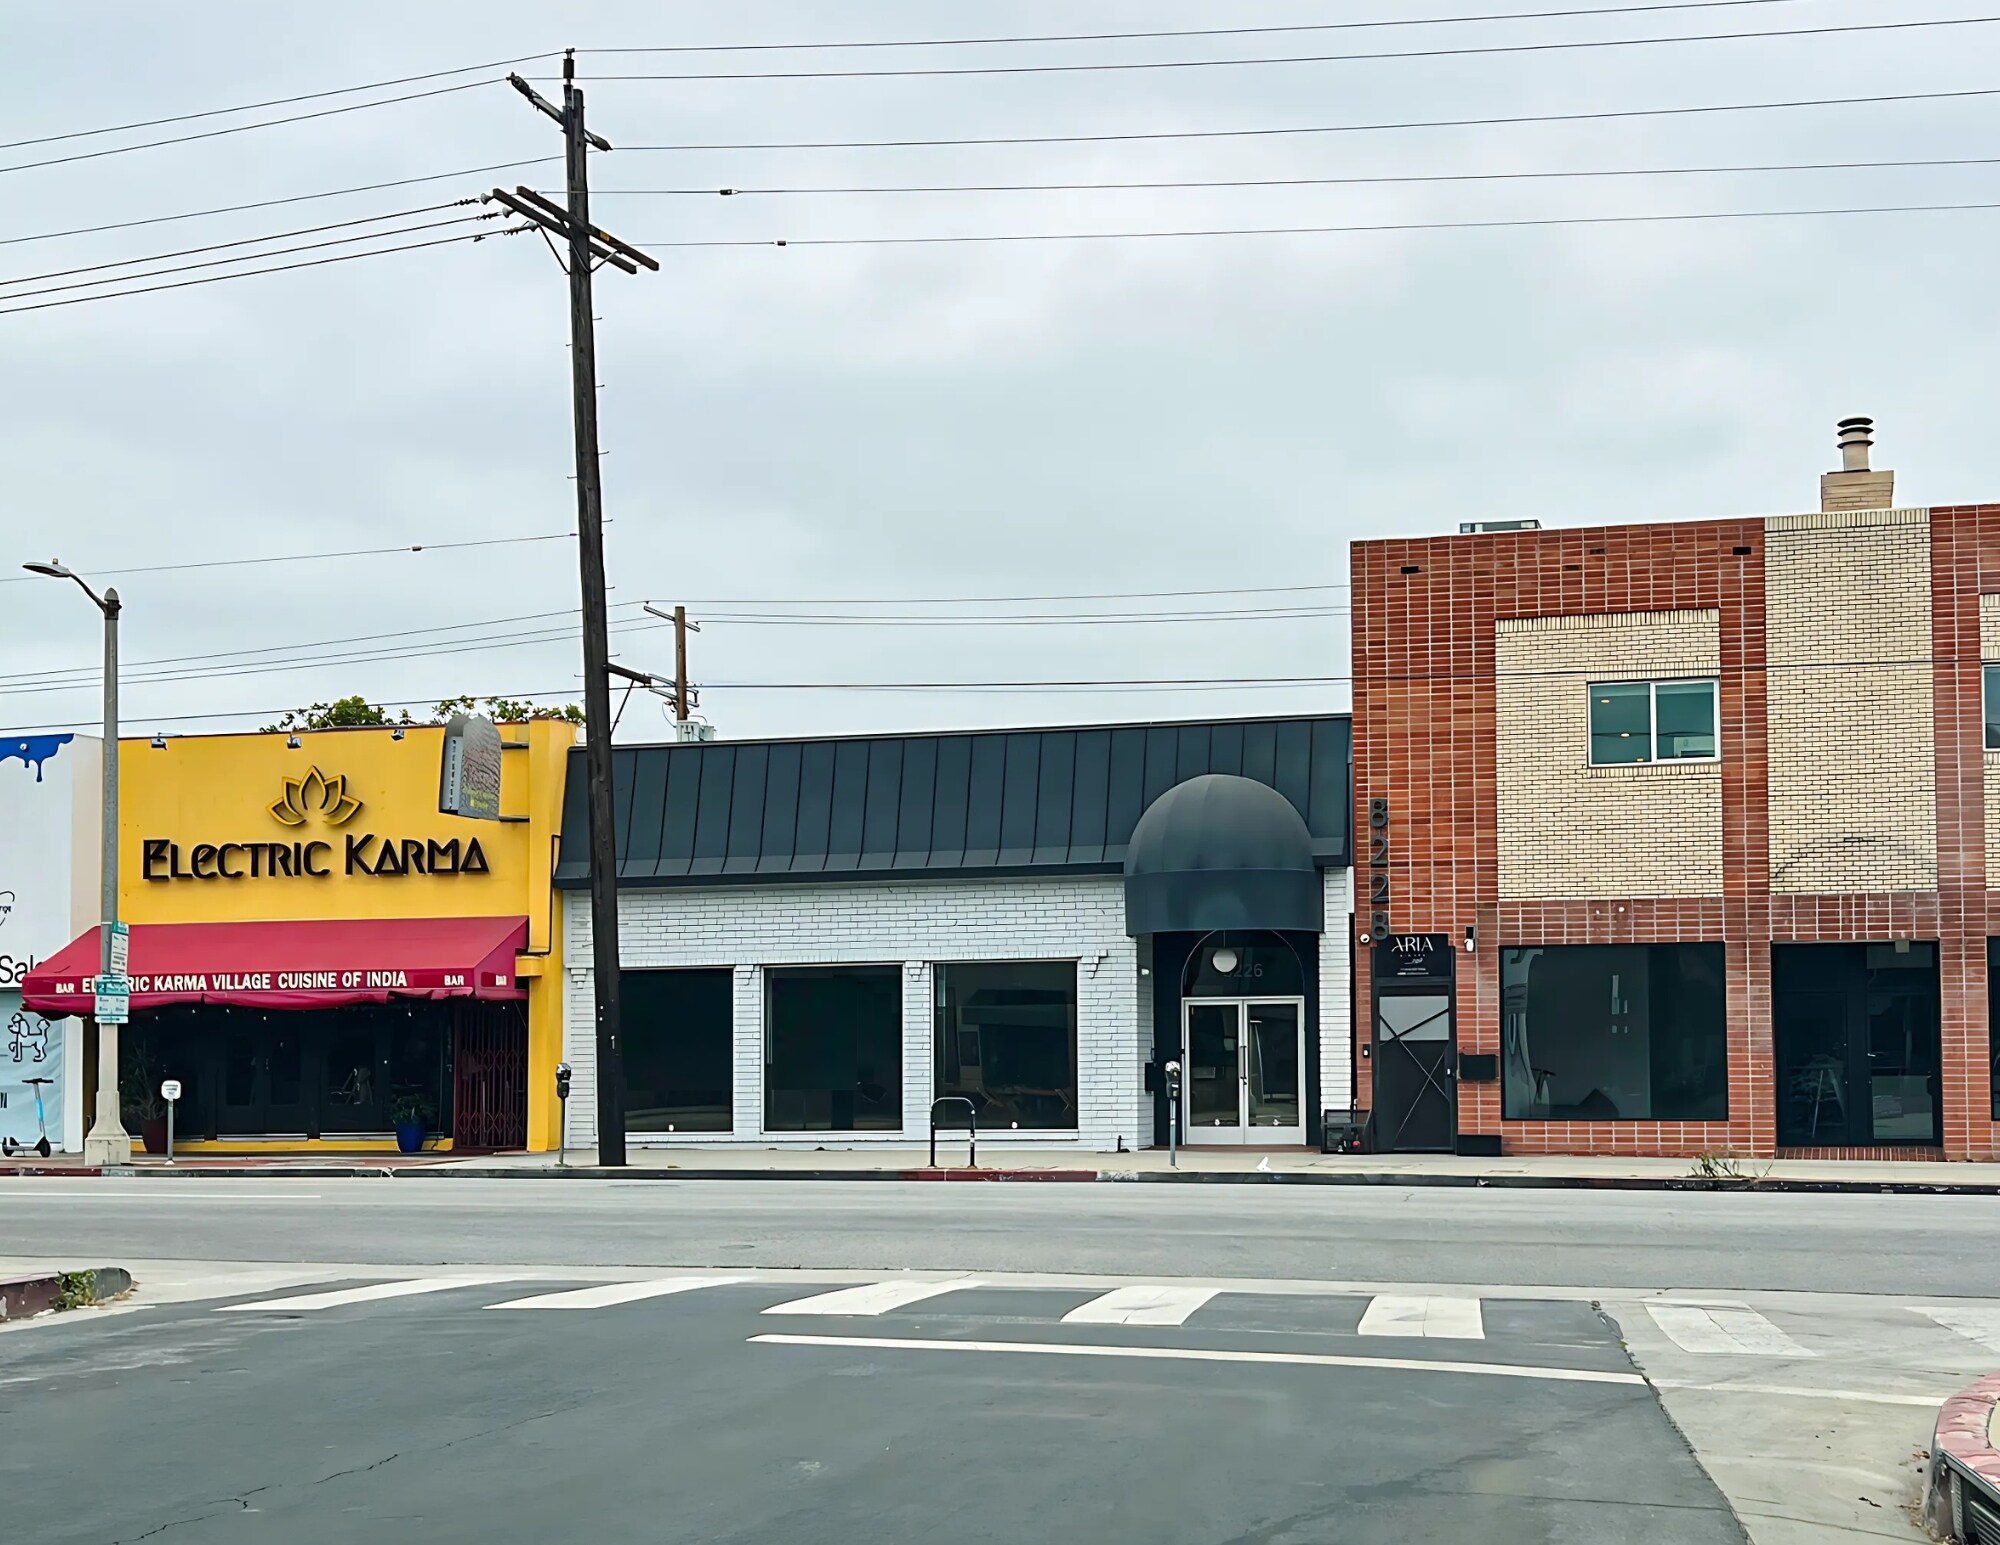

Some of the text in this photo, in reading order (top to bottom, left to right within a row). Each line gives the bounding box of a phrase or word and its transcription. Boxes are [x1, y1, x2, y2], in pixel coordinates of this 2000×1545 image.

[345, 833, 490, 876] KARMA
[1370, 799, 1389, 940] 8228
[1391, 936, 1434, 952] ARIA
[0, 954, 43, 984] Sal
[1222, 963, 1263, 978] 226
[56, 983, 75, 994] BAR
[82, 976, 150, 993] ELRIC
[154, 974, 207, 991] KARMA
[212, 973, 271, 990] VILLAGE
[277, 972, 337, 989] CUISINE
[341, 971, 362, 987] OF
[366, 971, 408, 987] INDIA
[443, 975, 465, 986] BAR
